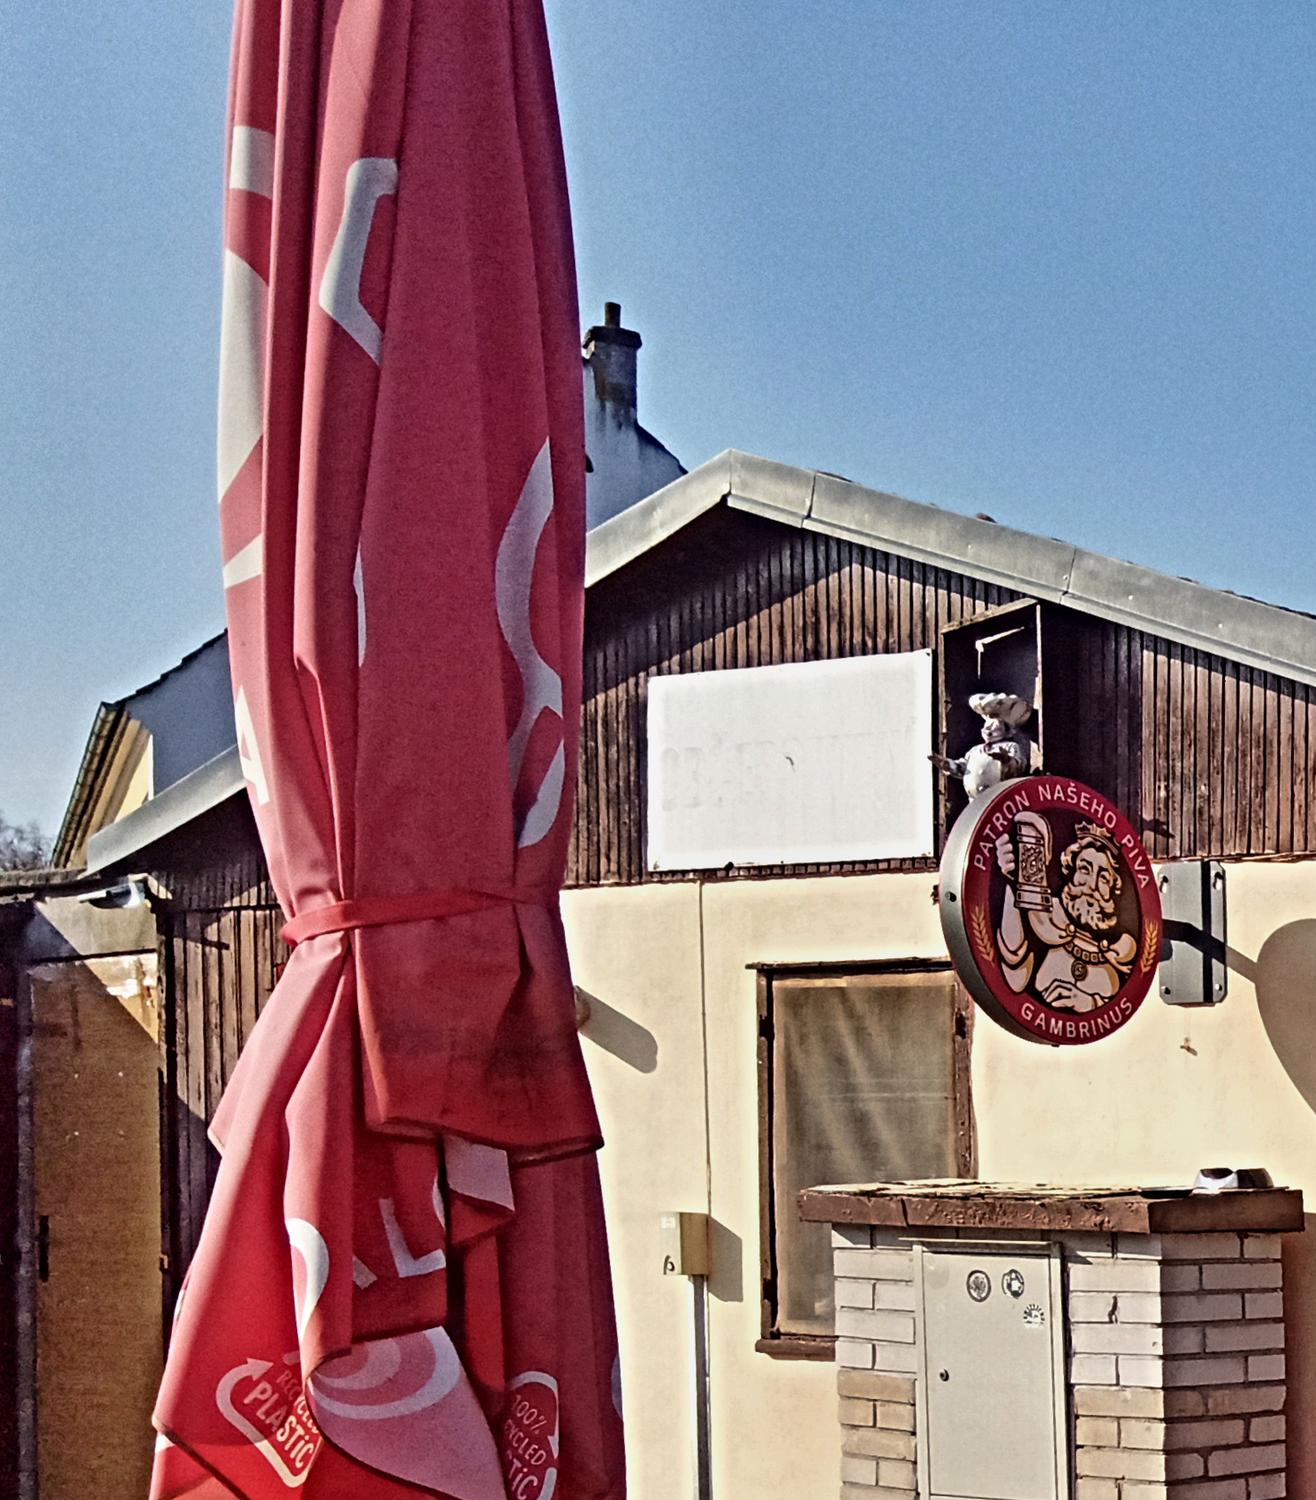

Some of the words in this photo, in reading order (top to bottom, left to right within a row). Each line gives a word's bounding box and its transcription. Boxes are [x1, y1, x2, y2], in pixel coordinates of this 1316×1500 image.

[974, 789, 1030, 871] PATRON
[1038, 782, 1117, 829] NAŠEHO
[1121, 835, 1149, 889] PIVA
[1020, 998, 1133, 1038] GAMBRINUS
